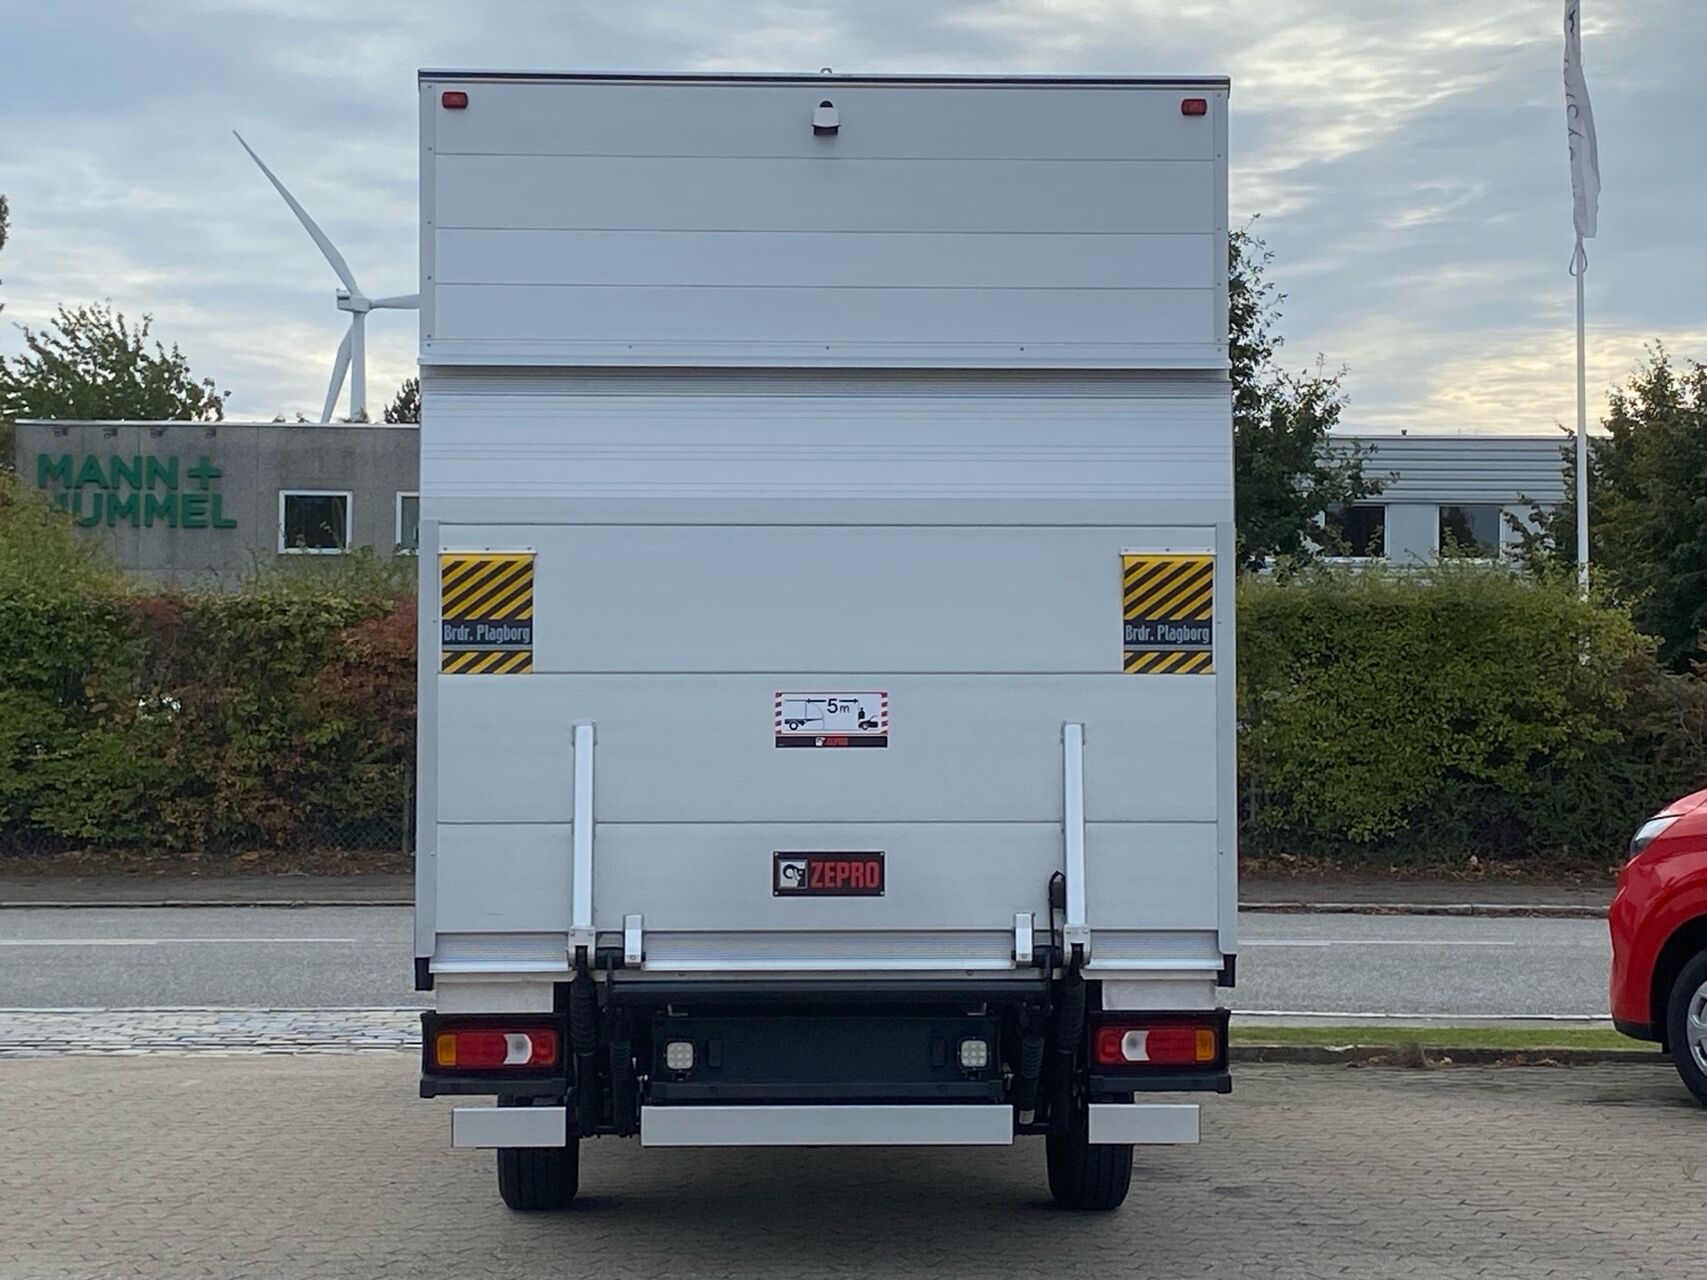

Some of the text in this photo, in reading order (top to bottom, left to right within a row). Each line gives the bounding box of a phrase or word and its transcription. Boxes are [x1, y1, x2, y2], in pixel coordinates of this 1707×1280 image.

[443, 624, 531, 644] Brdr. Plagborg
[1125, 624, 1210, 644] Brdr. Plagborg
[810, 861, 880, 888] ZEPRO
